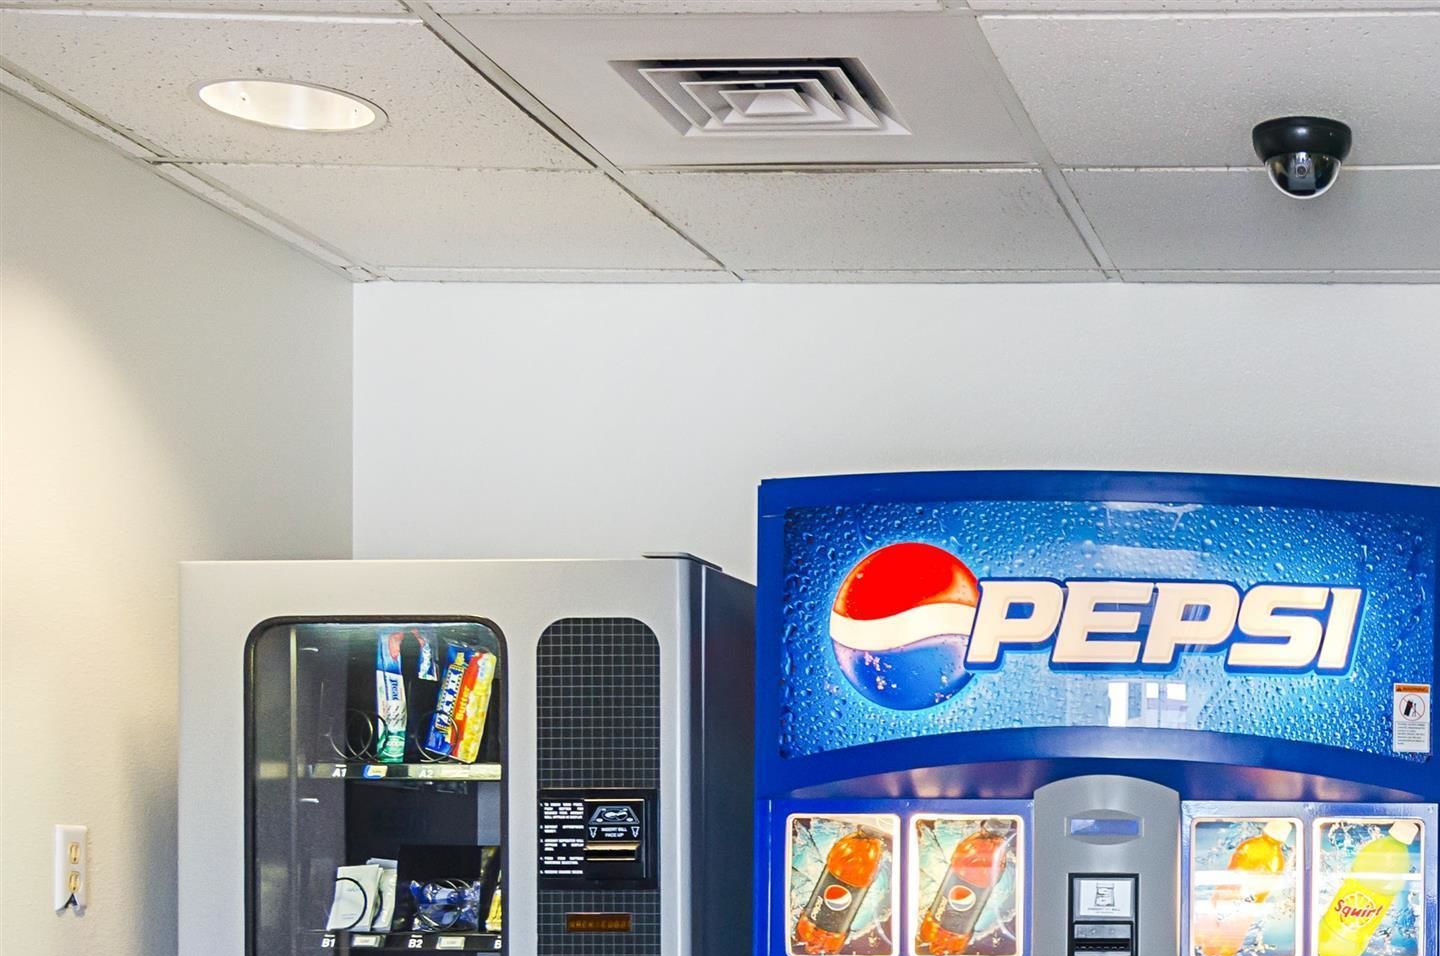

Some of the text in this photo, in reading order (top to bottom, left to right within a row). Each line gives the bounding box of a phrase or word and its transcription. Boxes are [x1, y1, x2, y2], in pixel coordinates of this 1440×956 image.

[965, 580, 1363, 670] PEPSI
[455, 687, 471, 721] Butter
[332, 768, 347, 778] A1
[419, 769, 433, 778] A2
[1334, 899, 1383, 918] Squirt
[321, 938, 336, 948] B1
[408, 939, 423, 949] B2
